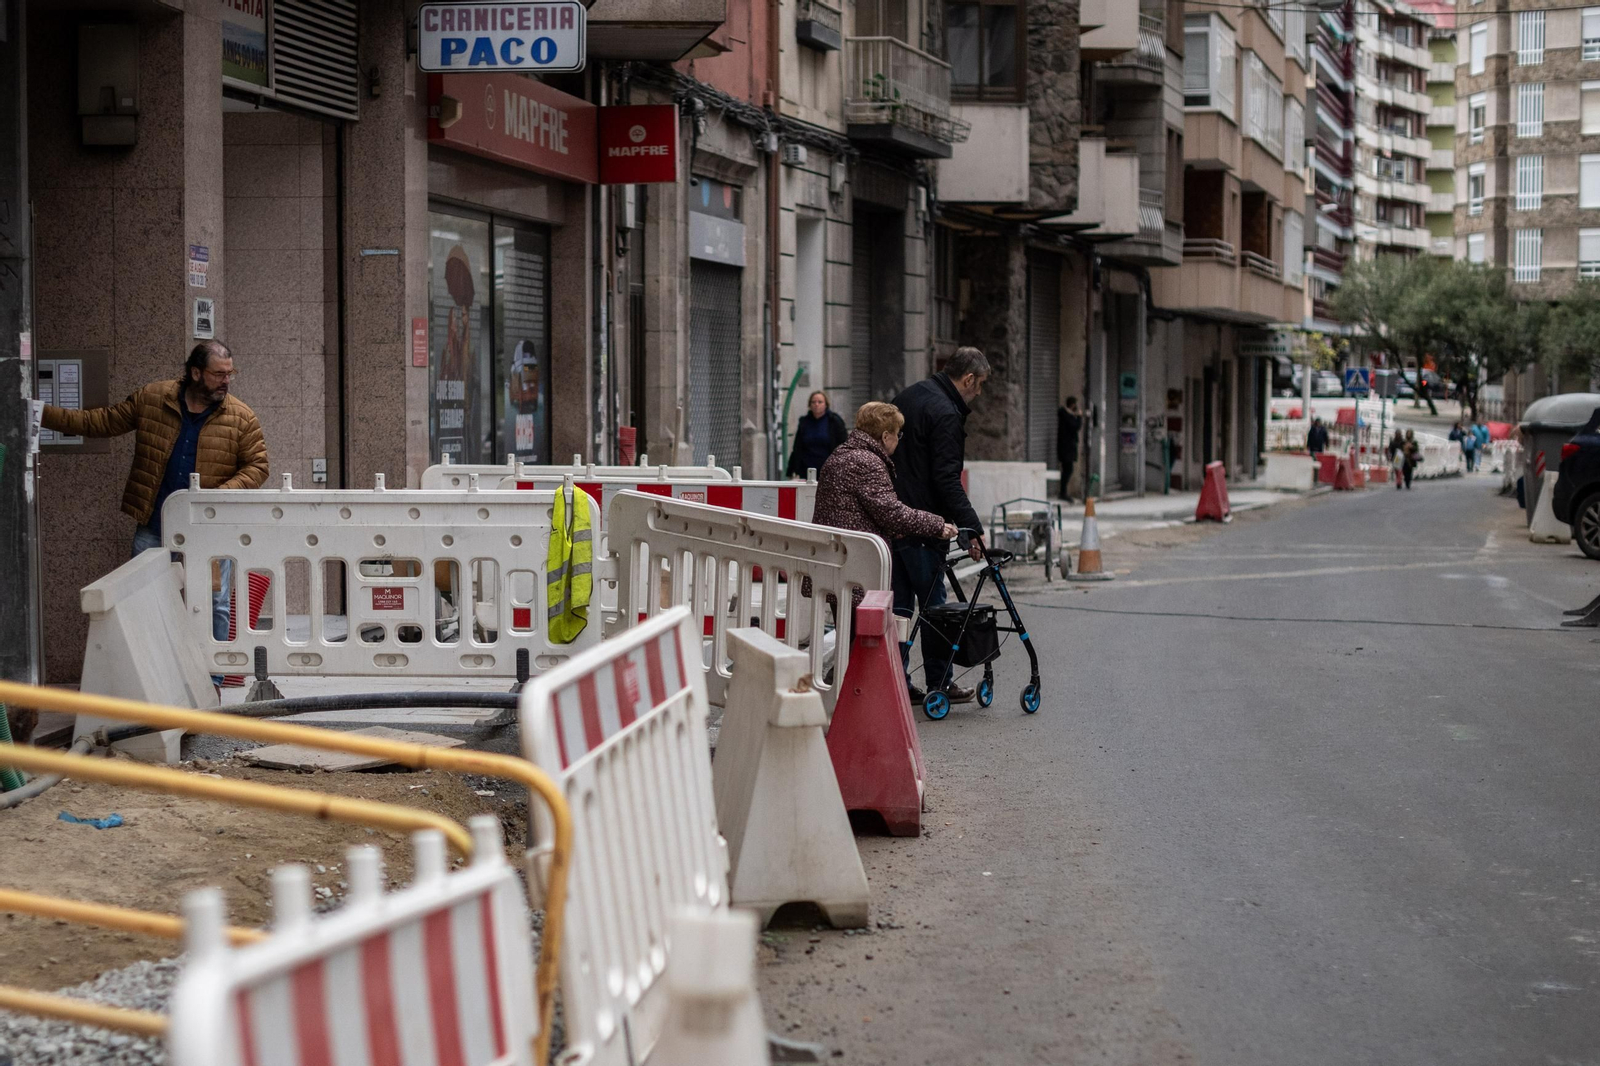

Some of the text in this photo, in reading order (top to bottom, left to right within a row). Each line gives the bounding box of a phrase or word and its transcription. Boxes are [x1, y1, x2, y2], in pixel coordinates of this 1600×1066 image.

[424, 6, 574, 32] CARNICERIA
[440, 36, 558, 66] PACO
[504, 89, 569, 155] MAPFRE
[608, 145, 669, 157] MAPFRE
